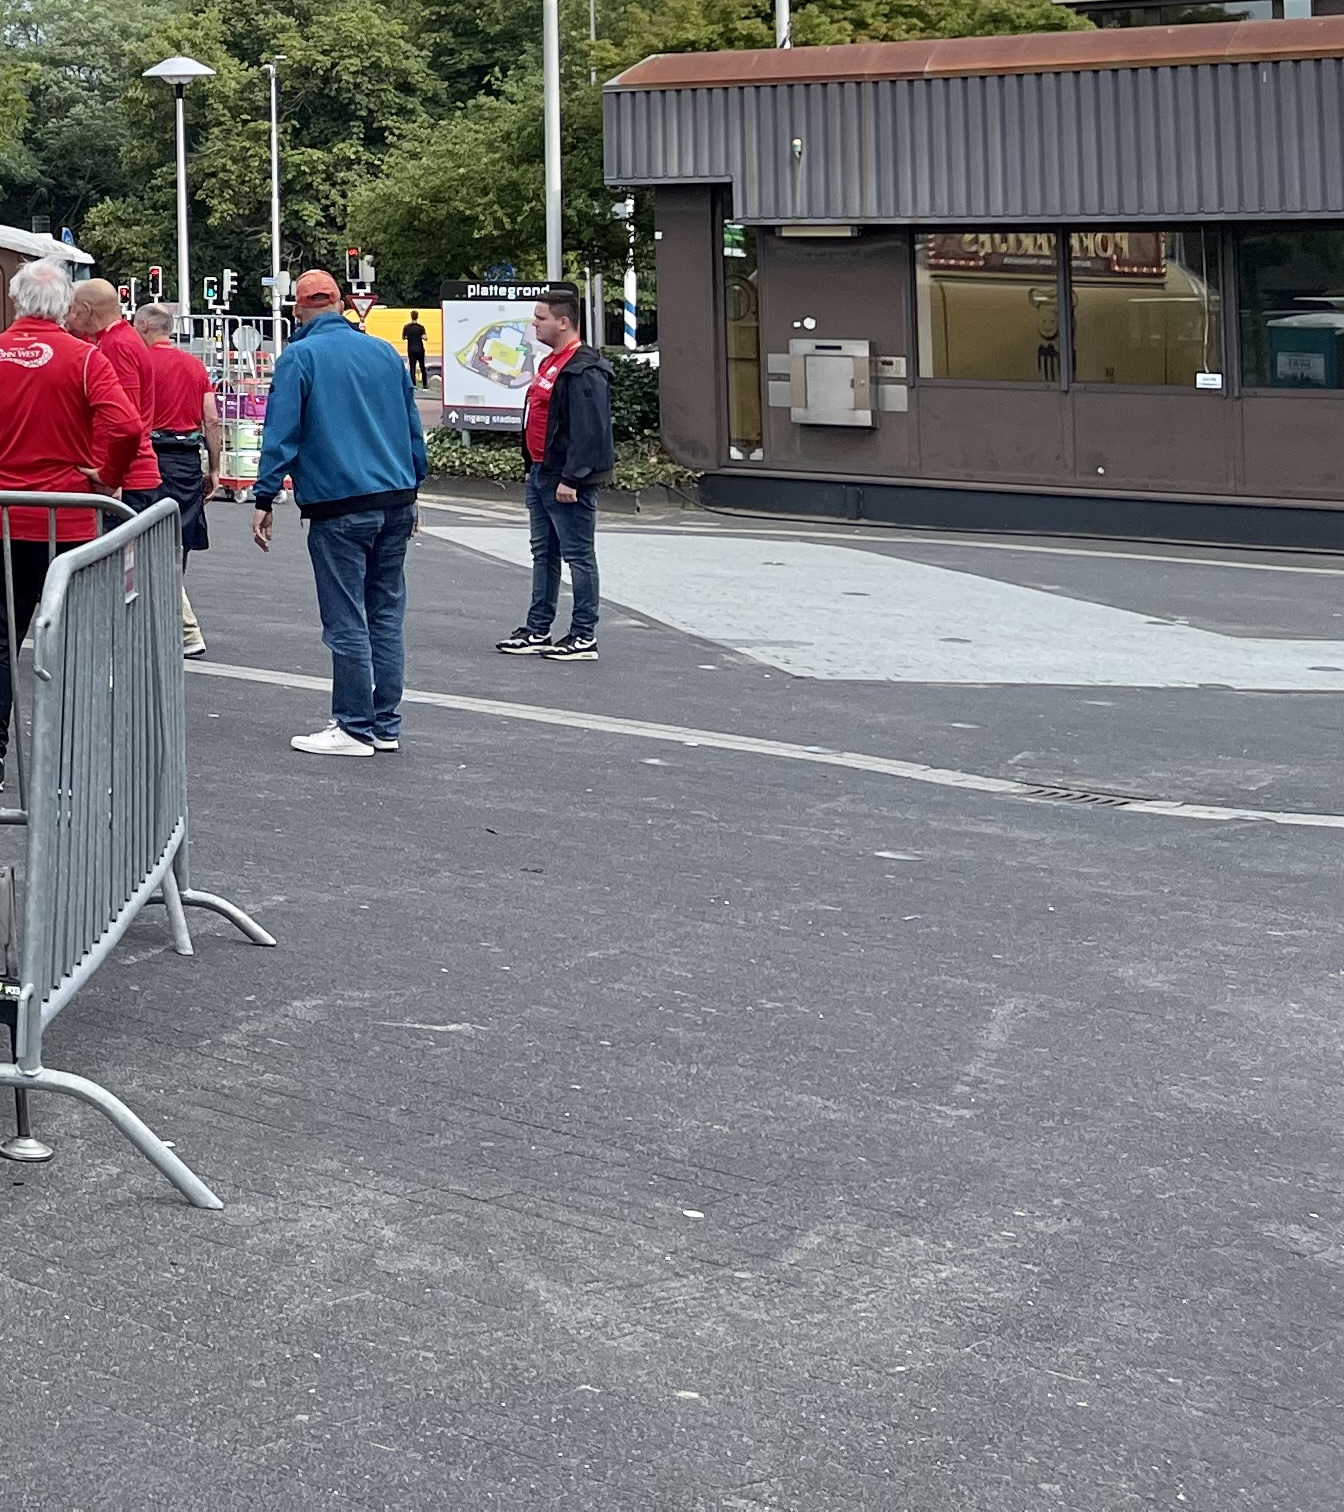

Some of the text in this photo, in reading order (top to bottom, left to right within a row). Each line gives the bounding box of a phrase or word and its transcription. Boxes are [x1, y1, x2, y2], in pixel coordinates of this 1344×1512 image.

[467, 284, 550, 300] plattegrond
[463, 413, 522, 425] ingang stadion
